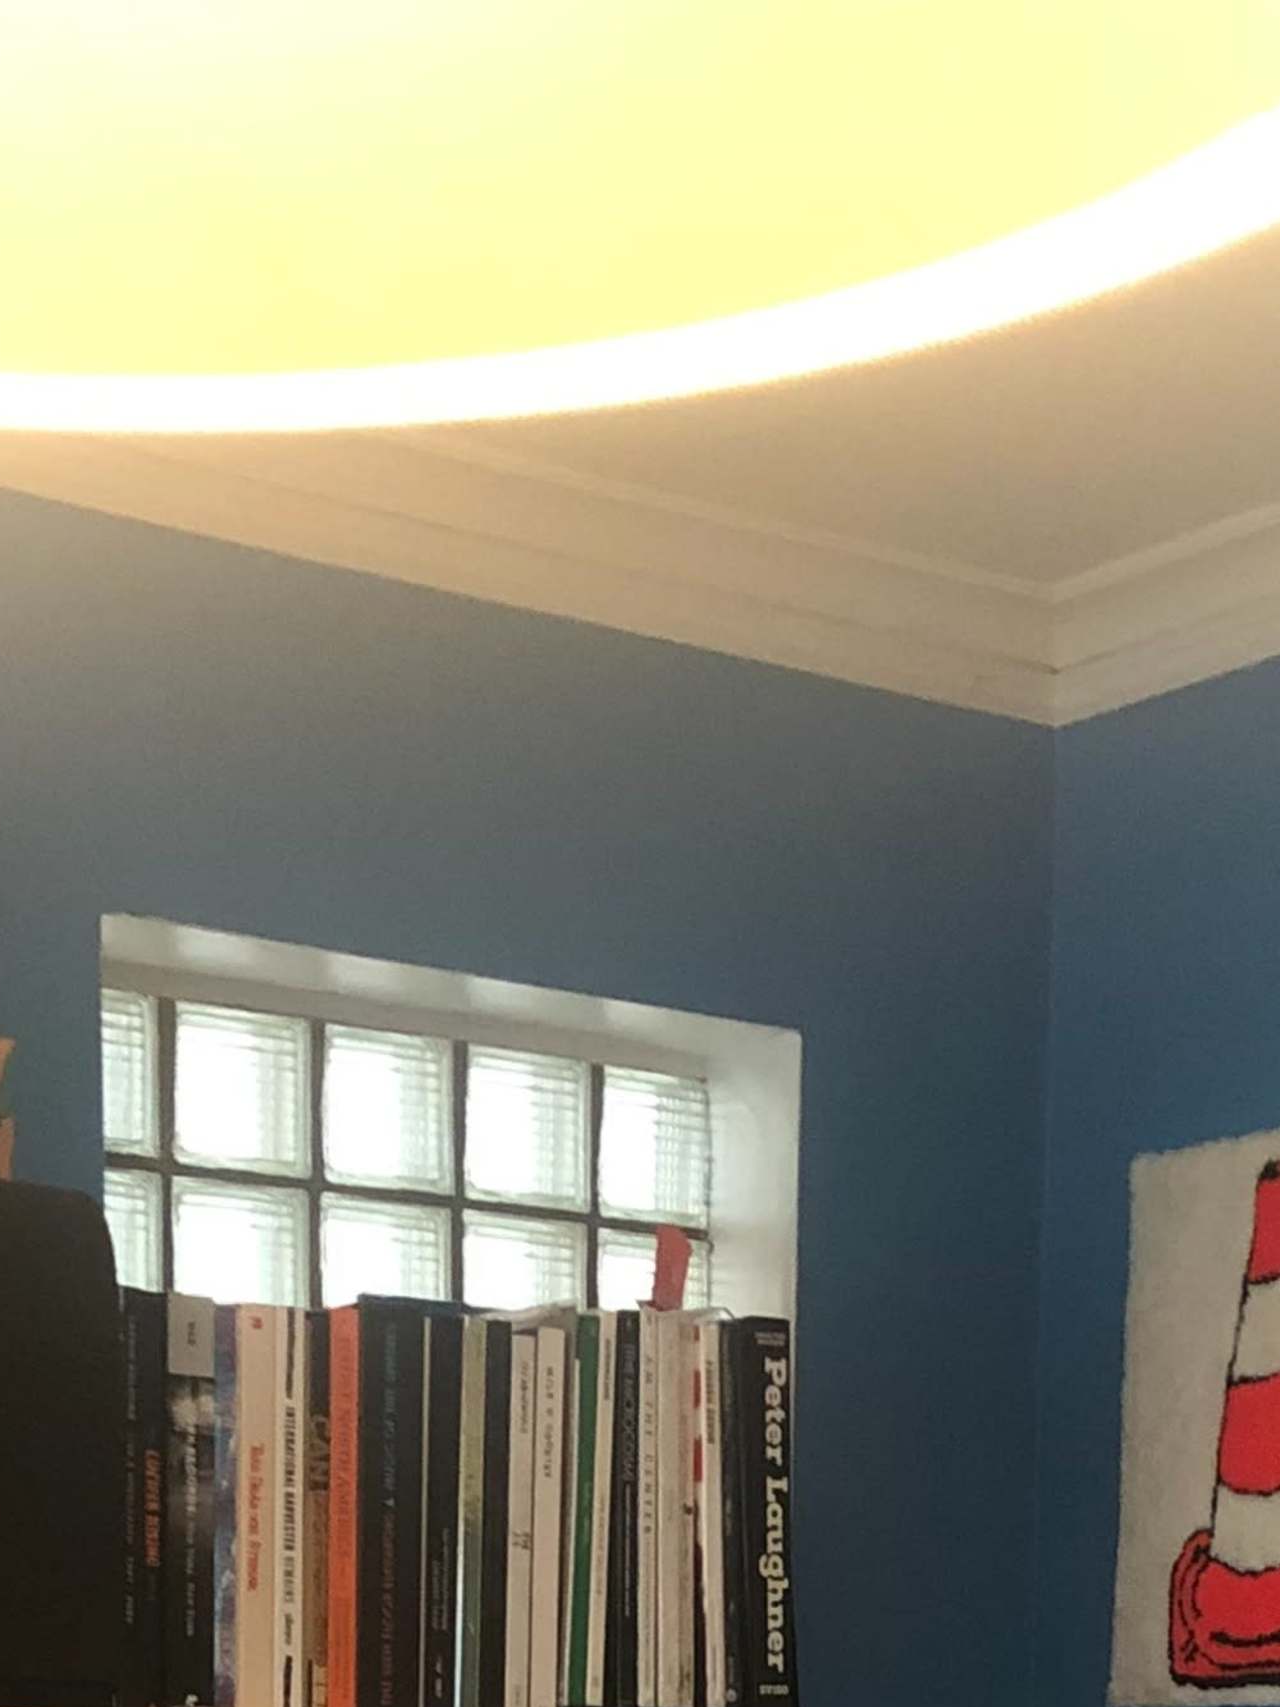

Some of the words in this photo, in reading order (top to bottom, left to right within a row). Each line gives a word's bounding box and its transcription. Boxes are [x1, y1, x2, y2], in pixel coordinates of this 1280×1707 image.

[283, 1406, 297, 1487] INTERNATIONAL
[764, 1356, 788, 1467] Peter
[145, 1448, 161, 1511] LUCIFER
[145, 1515, 161, 1567] RISING
[283, 1490, 296, 1551] HARVESTER
[758, 1474, 791, 1673] Laughner
